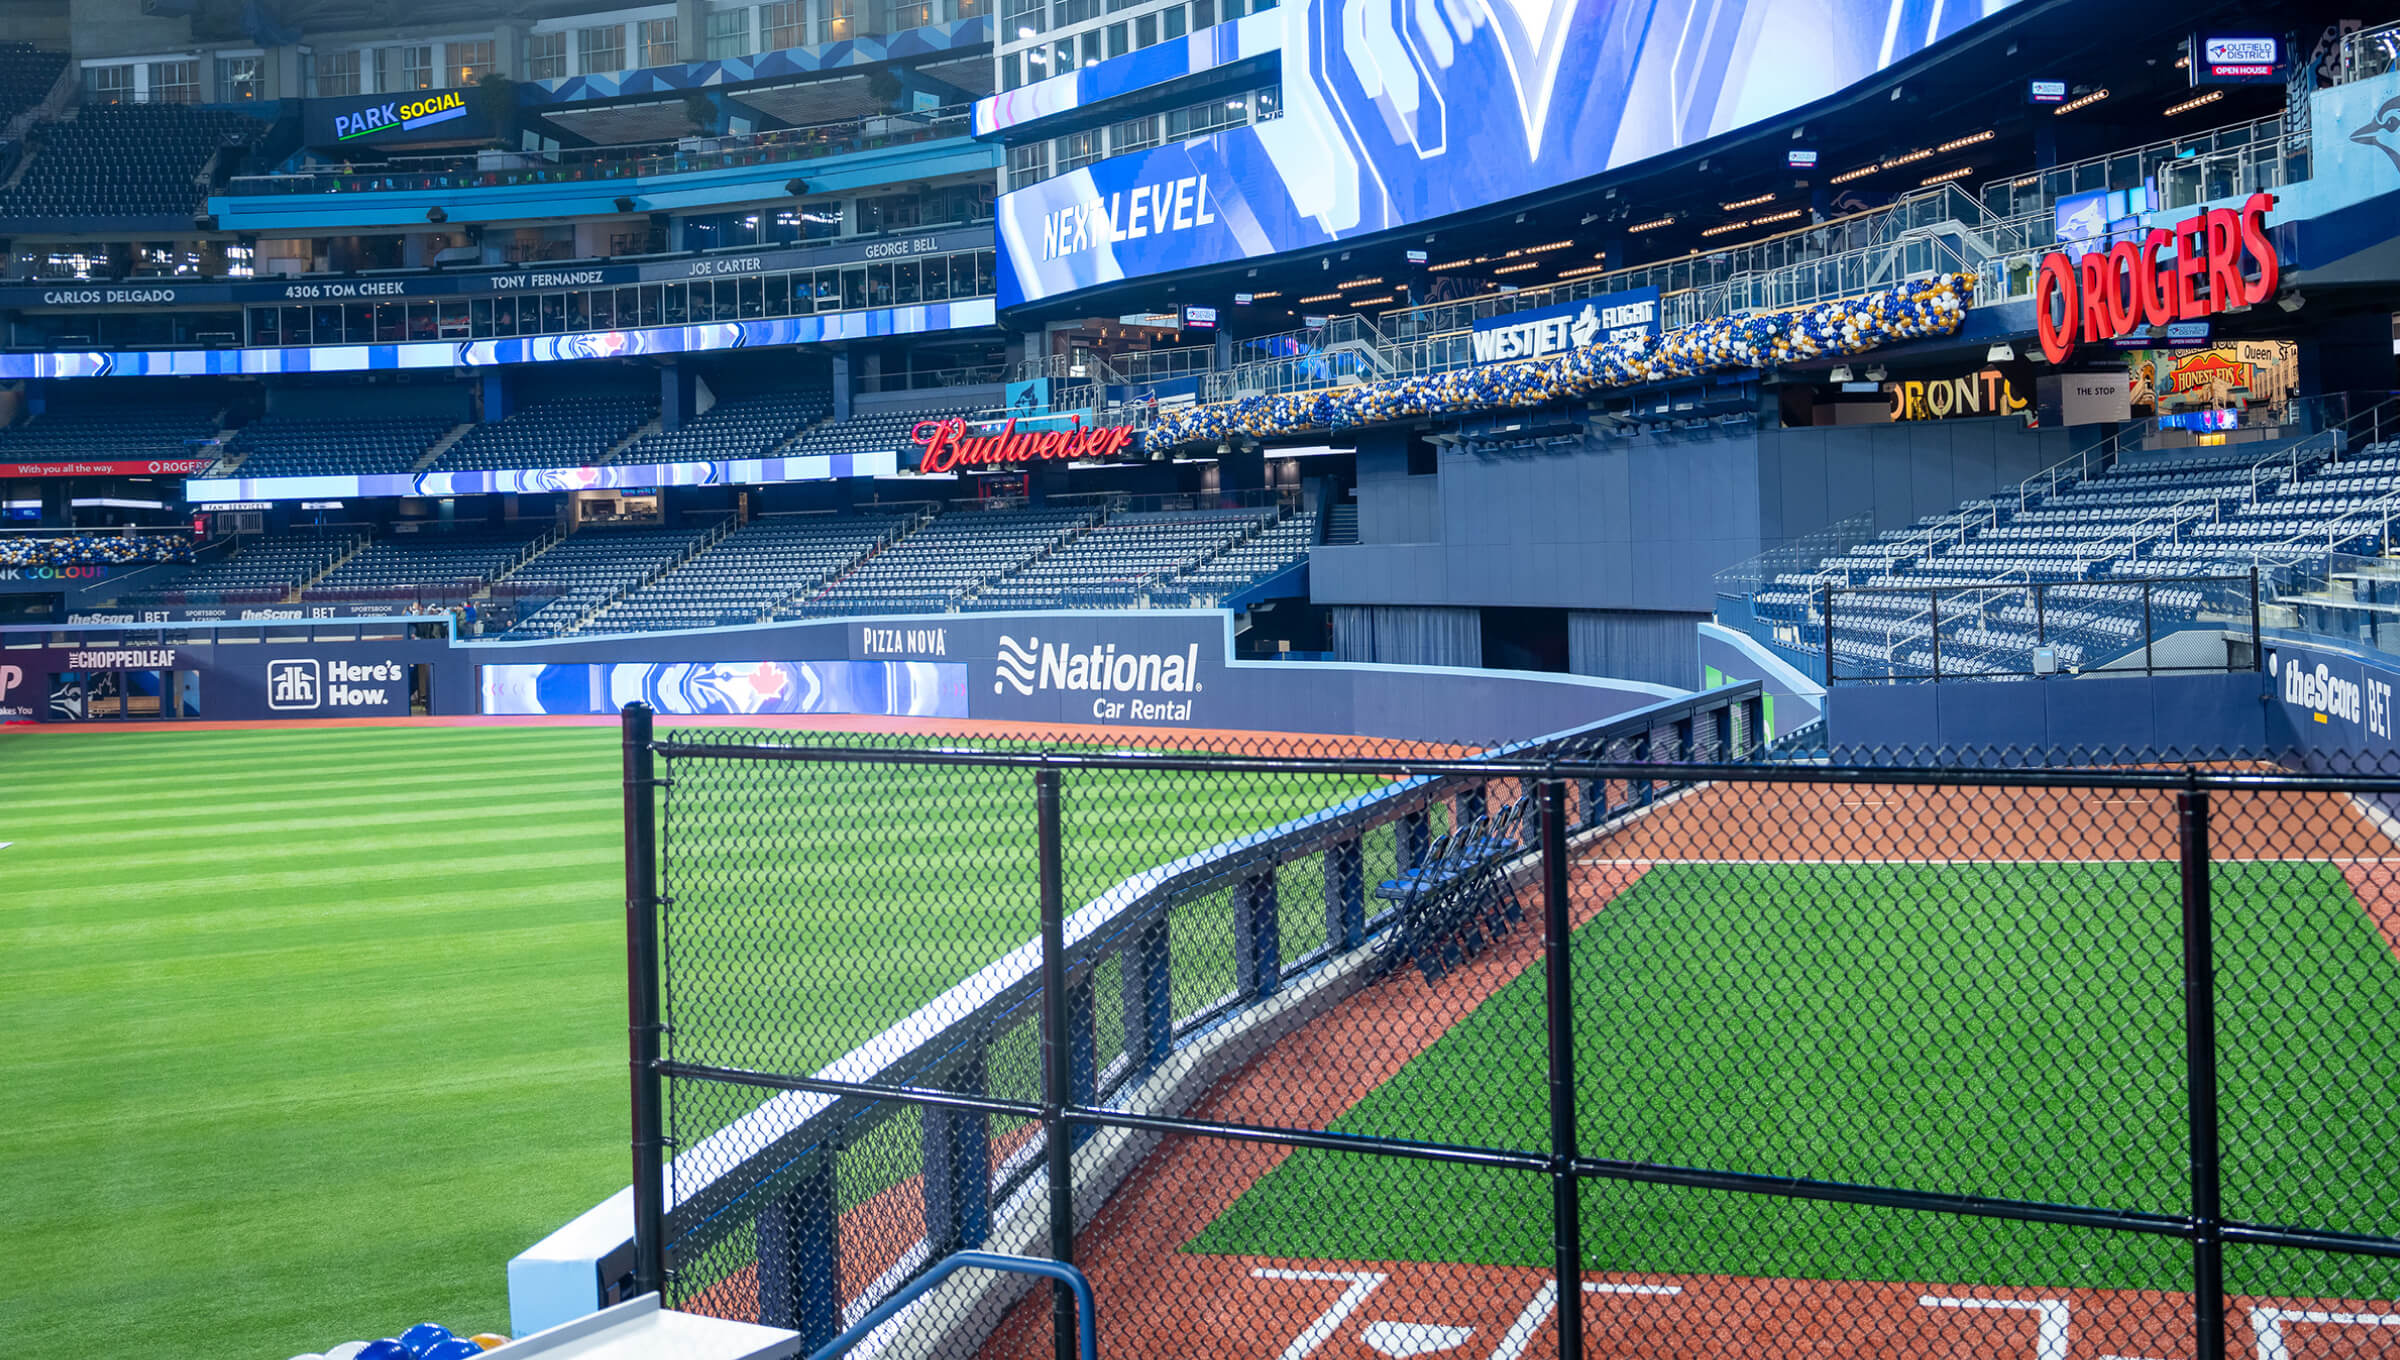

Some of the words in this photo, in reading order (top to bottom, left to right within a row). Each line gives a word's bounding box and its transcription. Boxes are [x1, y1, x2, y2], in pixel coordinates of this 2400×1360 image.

[2227, 51, 2272, 59] DISTRICT
[335, 102, 399, 138] PARK
[400, 91, 465, 120] SOCIAL
[1043, 196, 1105, 261] NEXT
[1109, 173, 1215, 243] LEVEL
[865, 241, 909, 258] GEORGE
[913, 237, 938, 252] BELL
[688, 262, 712, 275] JOE
[717, 257, 761, 273] CARTER
[2081, 193, 2279, 343] ROGERS
[491, 275, 526, 289] TONY
[531, 271, 604, 287] FERNANDEZ
[44, 291, 101, 304] CARLOS
[106, 289, 175, 303] DELGADO
[285, 286, 320, 298] 4306
[323, 284, 356, 297] TOM
[359, 282, 405, 295] CHEEK
[1472, 315, 1574, 363] WESTJET
[1602, 300, 1656, 329] FLIGHT
[2244, 344, 2272, 360] Queen
[2178, 369, 2214, 392] HONEST
[2077, 387, 2092, 395] THE
[2095, 387, 2116, 395] STOP
[911, 414, 1134, 474] Budweiser
[18, 465, 41, 474] With
[43, 466, 60, 475] you
[63, 464, 75, 473] all
[76, 464, 91, 473] the
[93, 464, 115, 475] way.
[24, 566, 108, 579] COLOUR
[67, 613, 134, 624] theScore
[144, 611, 170, 622] BET
[241, 608, 303, 620] theScore
[312, 607, 336, 619] BET
[351, 605, 393, 613] SPORTSBOOK
[864, 627, 903, 655] PIZZA
[907, 627, 946, 656] NOVA
[69, 652, 79, 669] THE
[79, 649, 175, 669] CHOPPEDLEAF
[1039, 643, 1199, 693] National
[328, 659, 402, 682] Here's
[329, 684, 388, 706] How.
[2285, 659, 2360, 724] theScore
[2367, 678, 2391, 741] BET
[17, 706, 33, 715] You
[1093, 697, 1124, 719] Car
[1130, 699, 1192, 721] Rental
